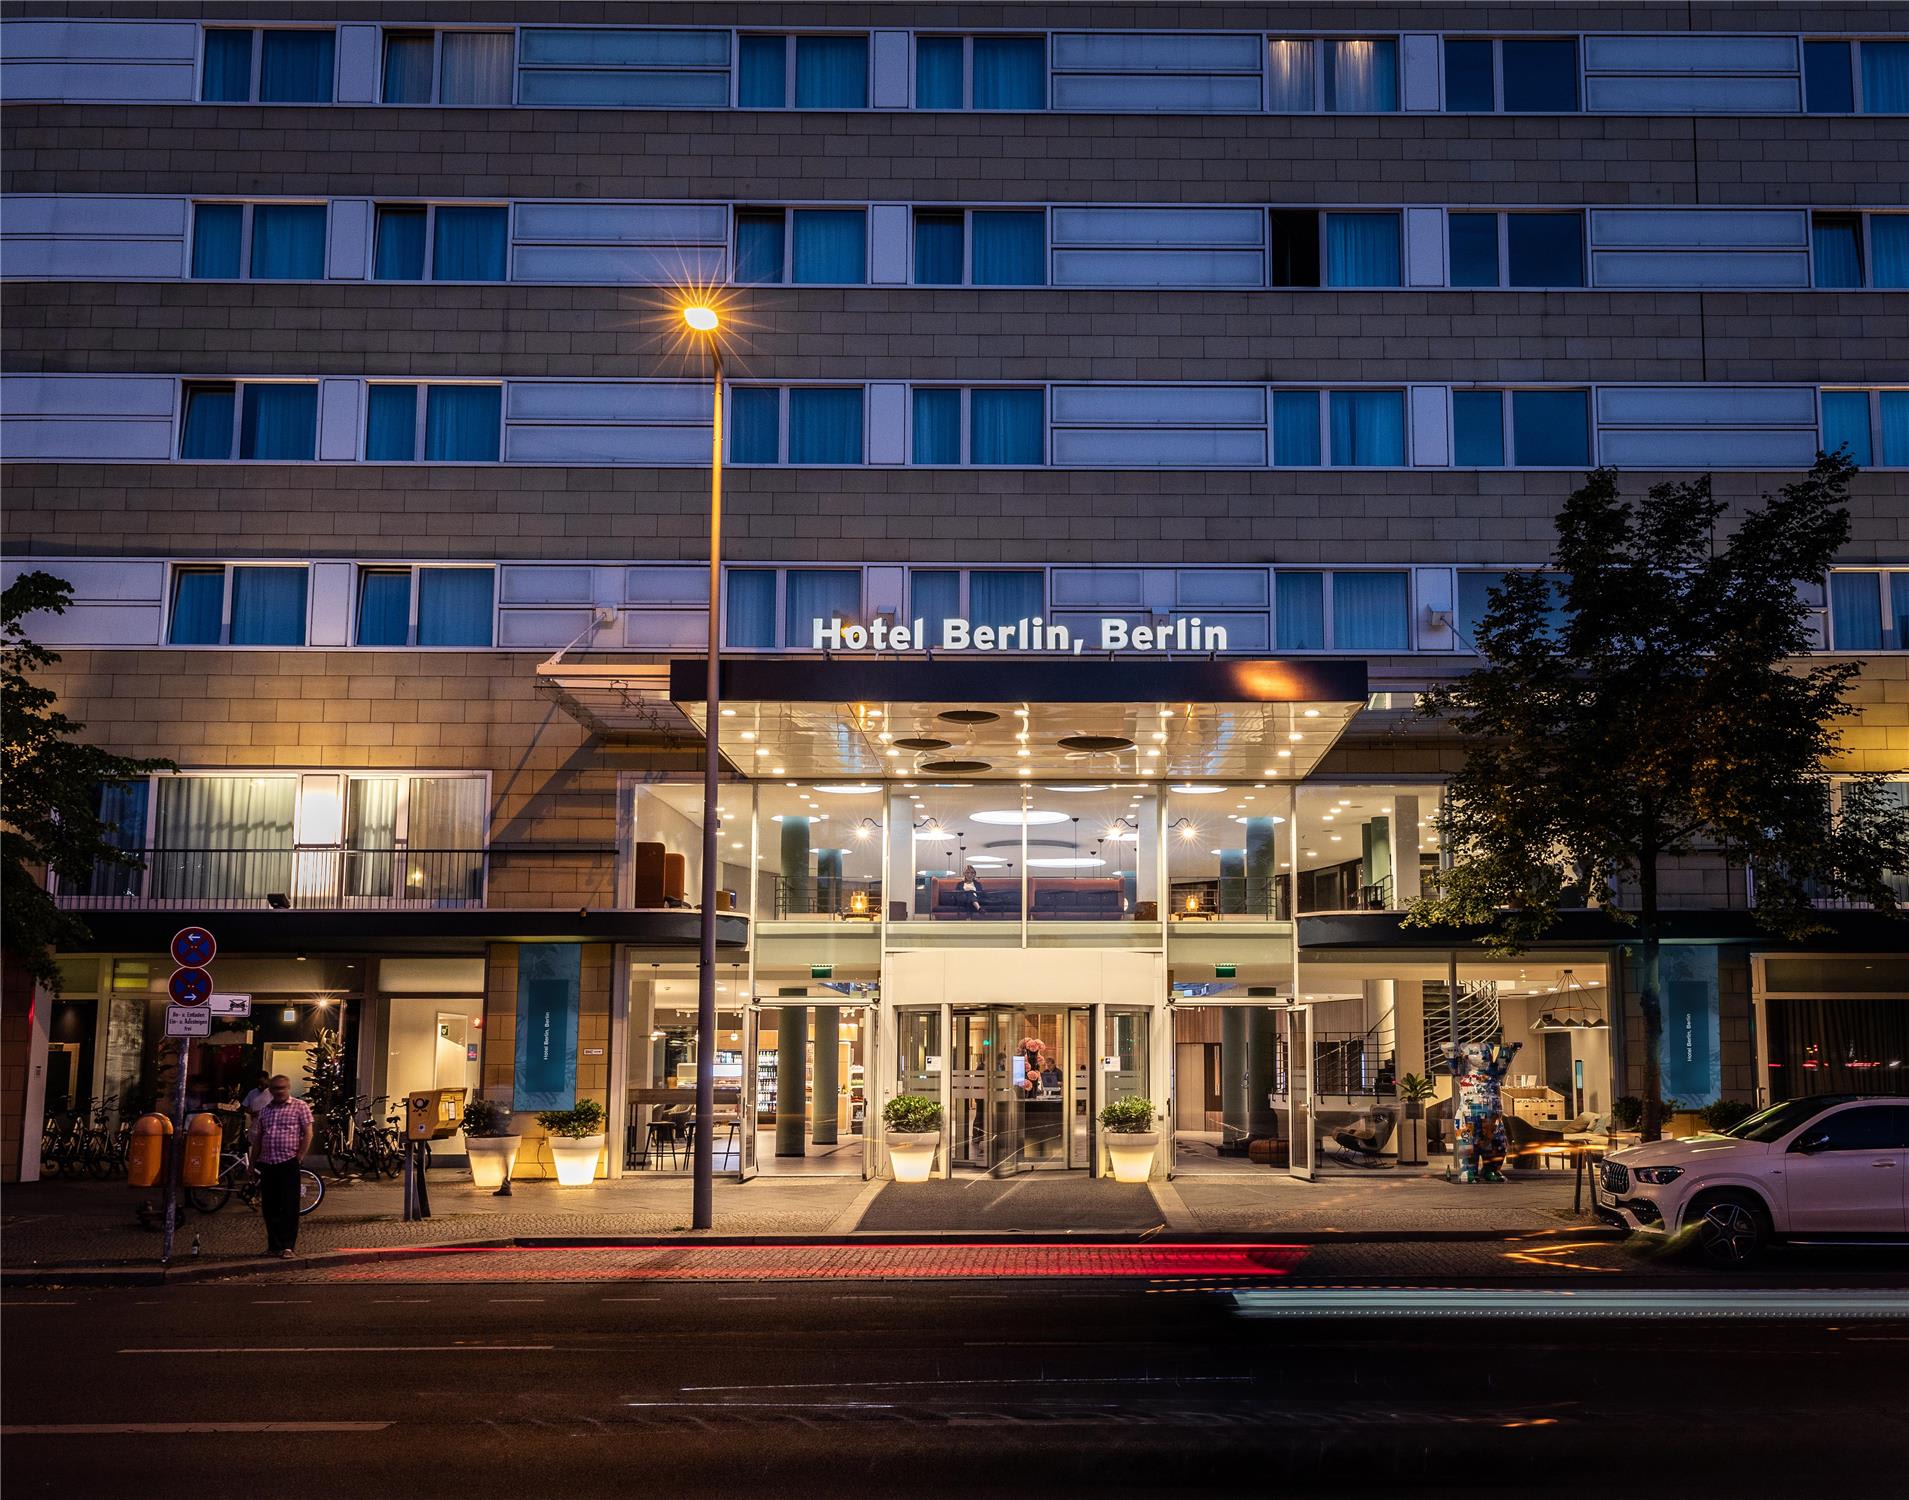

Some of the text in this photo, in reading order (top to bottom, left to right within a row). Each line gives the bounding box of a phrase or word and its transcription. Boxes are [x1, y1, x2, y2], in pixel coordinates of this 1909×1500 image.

[812, 617, 1228, 656] Hotel Berlin, Berlin
